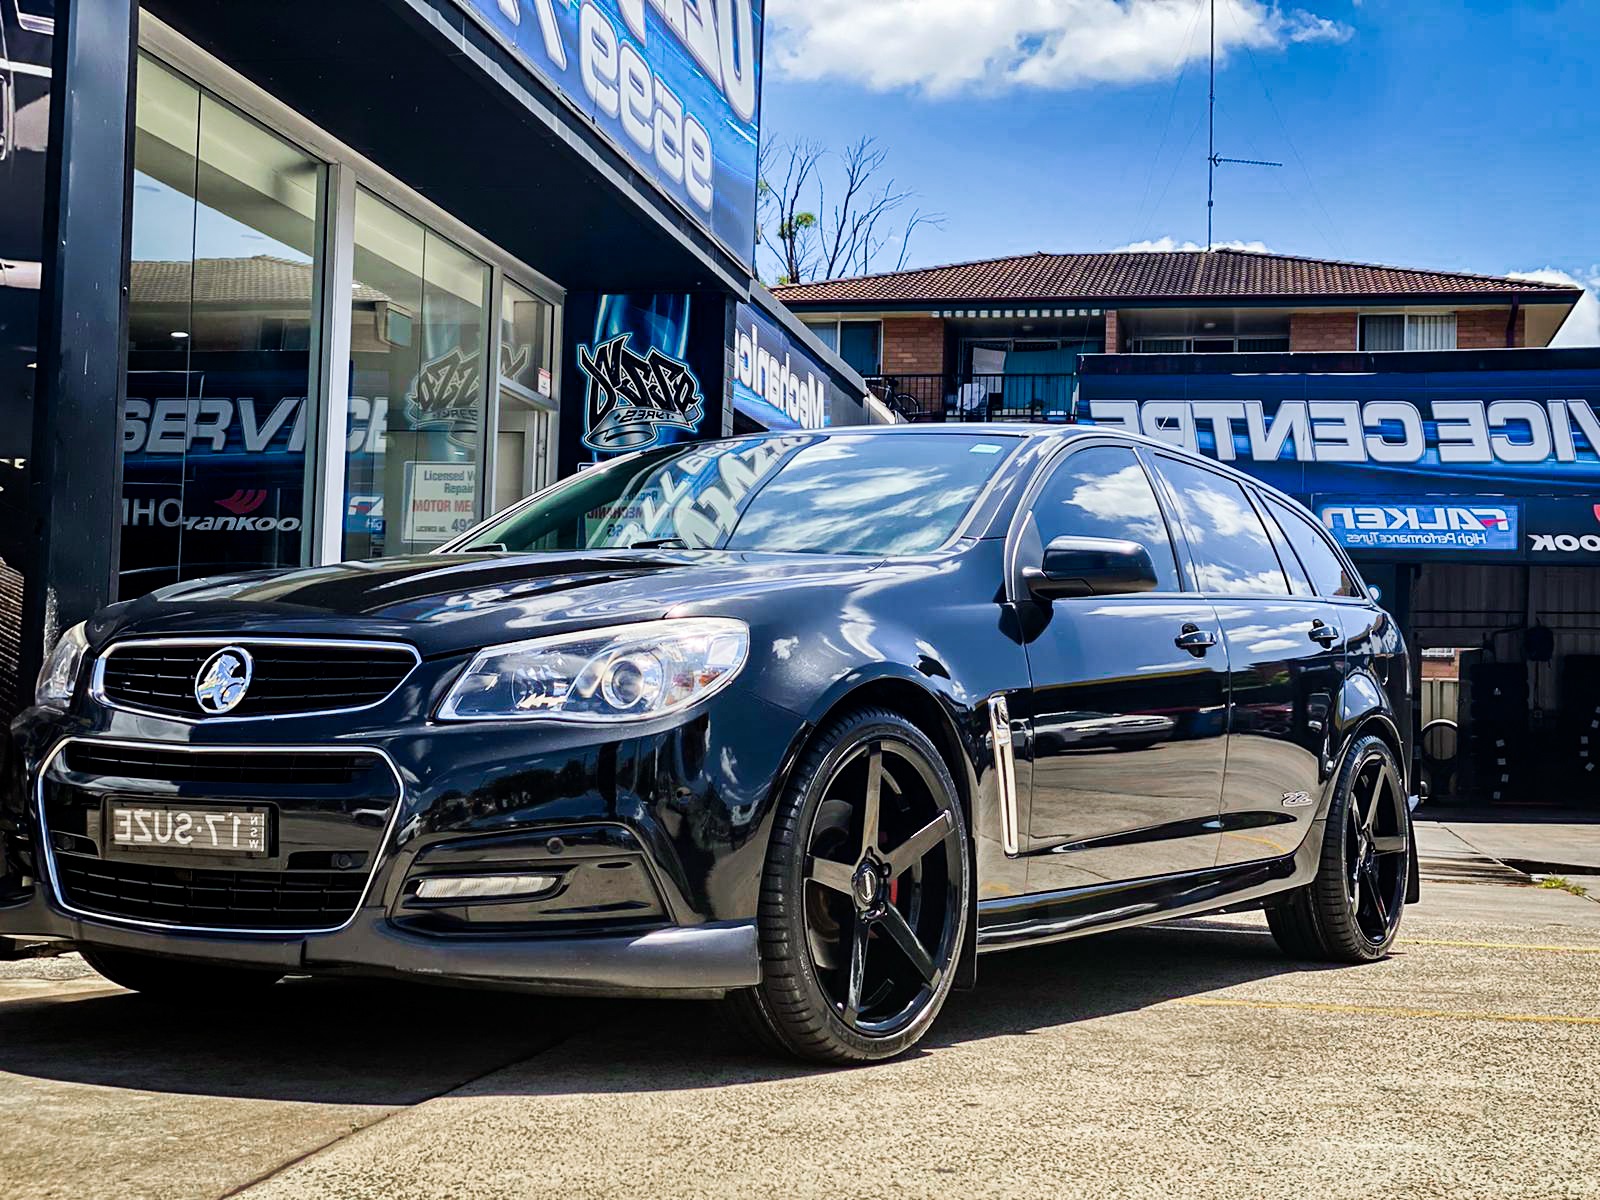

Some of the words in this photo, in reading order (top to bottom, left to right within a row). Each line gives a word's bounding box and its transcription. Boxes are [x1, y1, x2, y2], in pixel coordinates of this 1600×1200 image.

[424, 470, 464, 481] Licensed
[412, 500, 451, 512] MOTOR
[454, 500, 473, 512] ME
